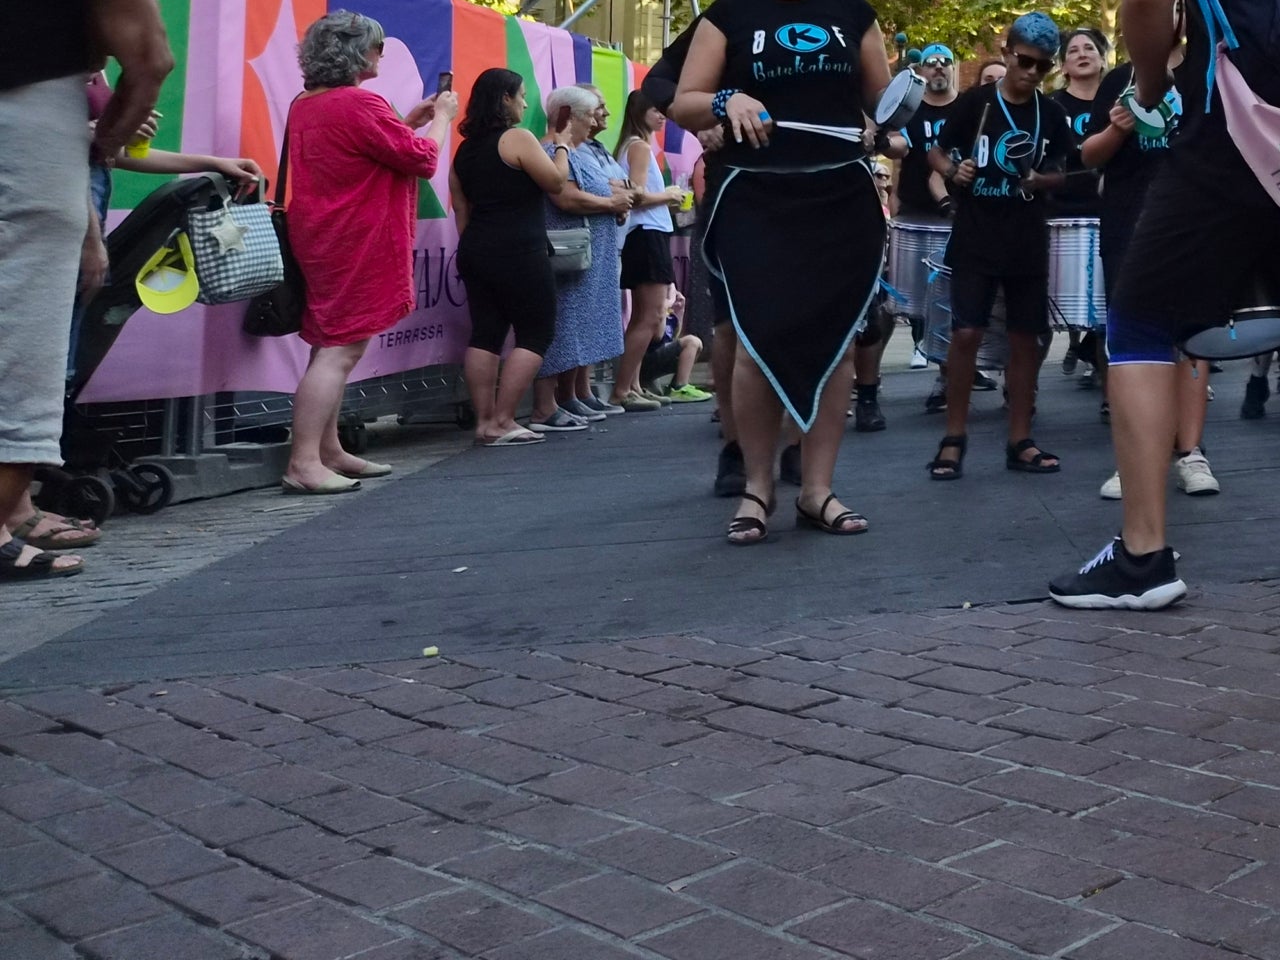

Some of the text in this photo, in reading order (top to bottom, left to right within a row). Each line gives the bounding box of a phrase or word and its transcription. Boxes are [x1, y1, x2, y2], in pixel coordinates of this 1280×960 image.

[786, 26, 823, 48] K
[831, 25, 847, 48] F
[379, 324, 444, 349] TERRASSA
